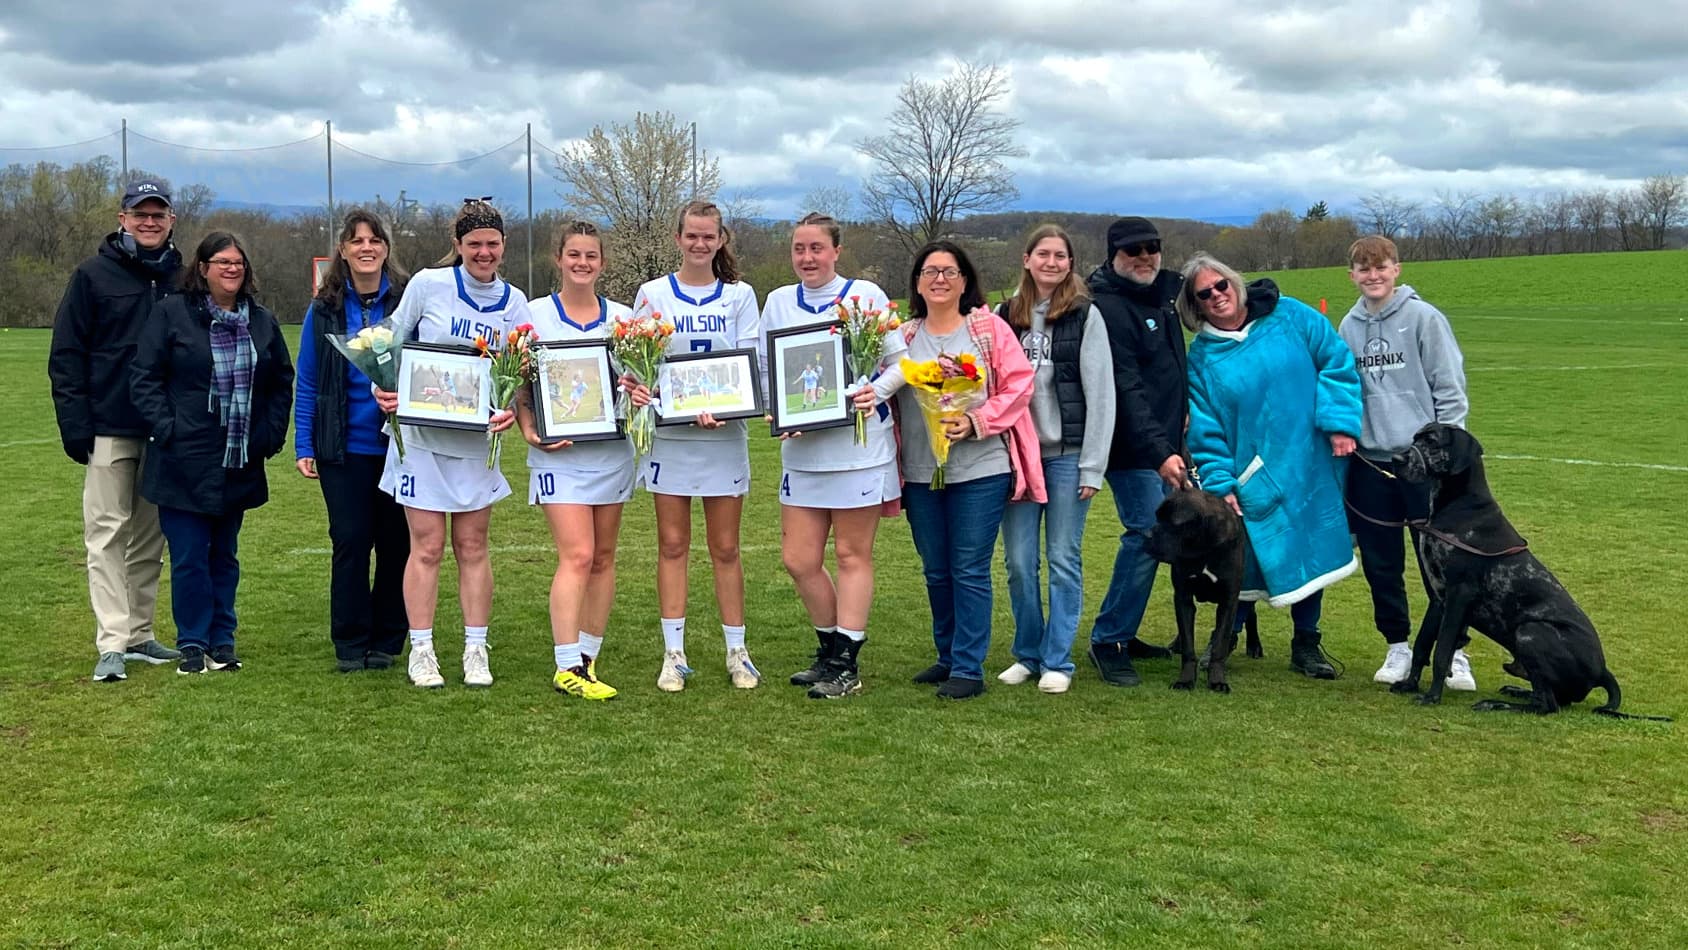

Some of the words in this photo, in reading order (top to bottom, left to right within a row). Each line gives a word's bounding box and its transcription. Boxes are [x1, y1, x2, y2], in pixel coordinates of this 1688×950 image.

[674, 314, 727, 333] WILSON
[538, 472, 555, 496] 10
[650, 461, 661, 485] 7
[782, 473, 791, 497] 4
[400, 474, 416, 498] 21
